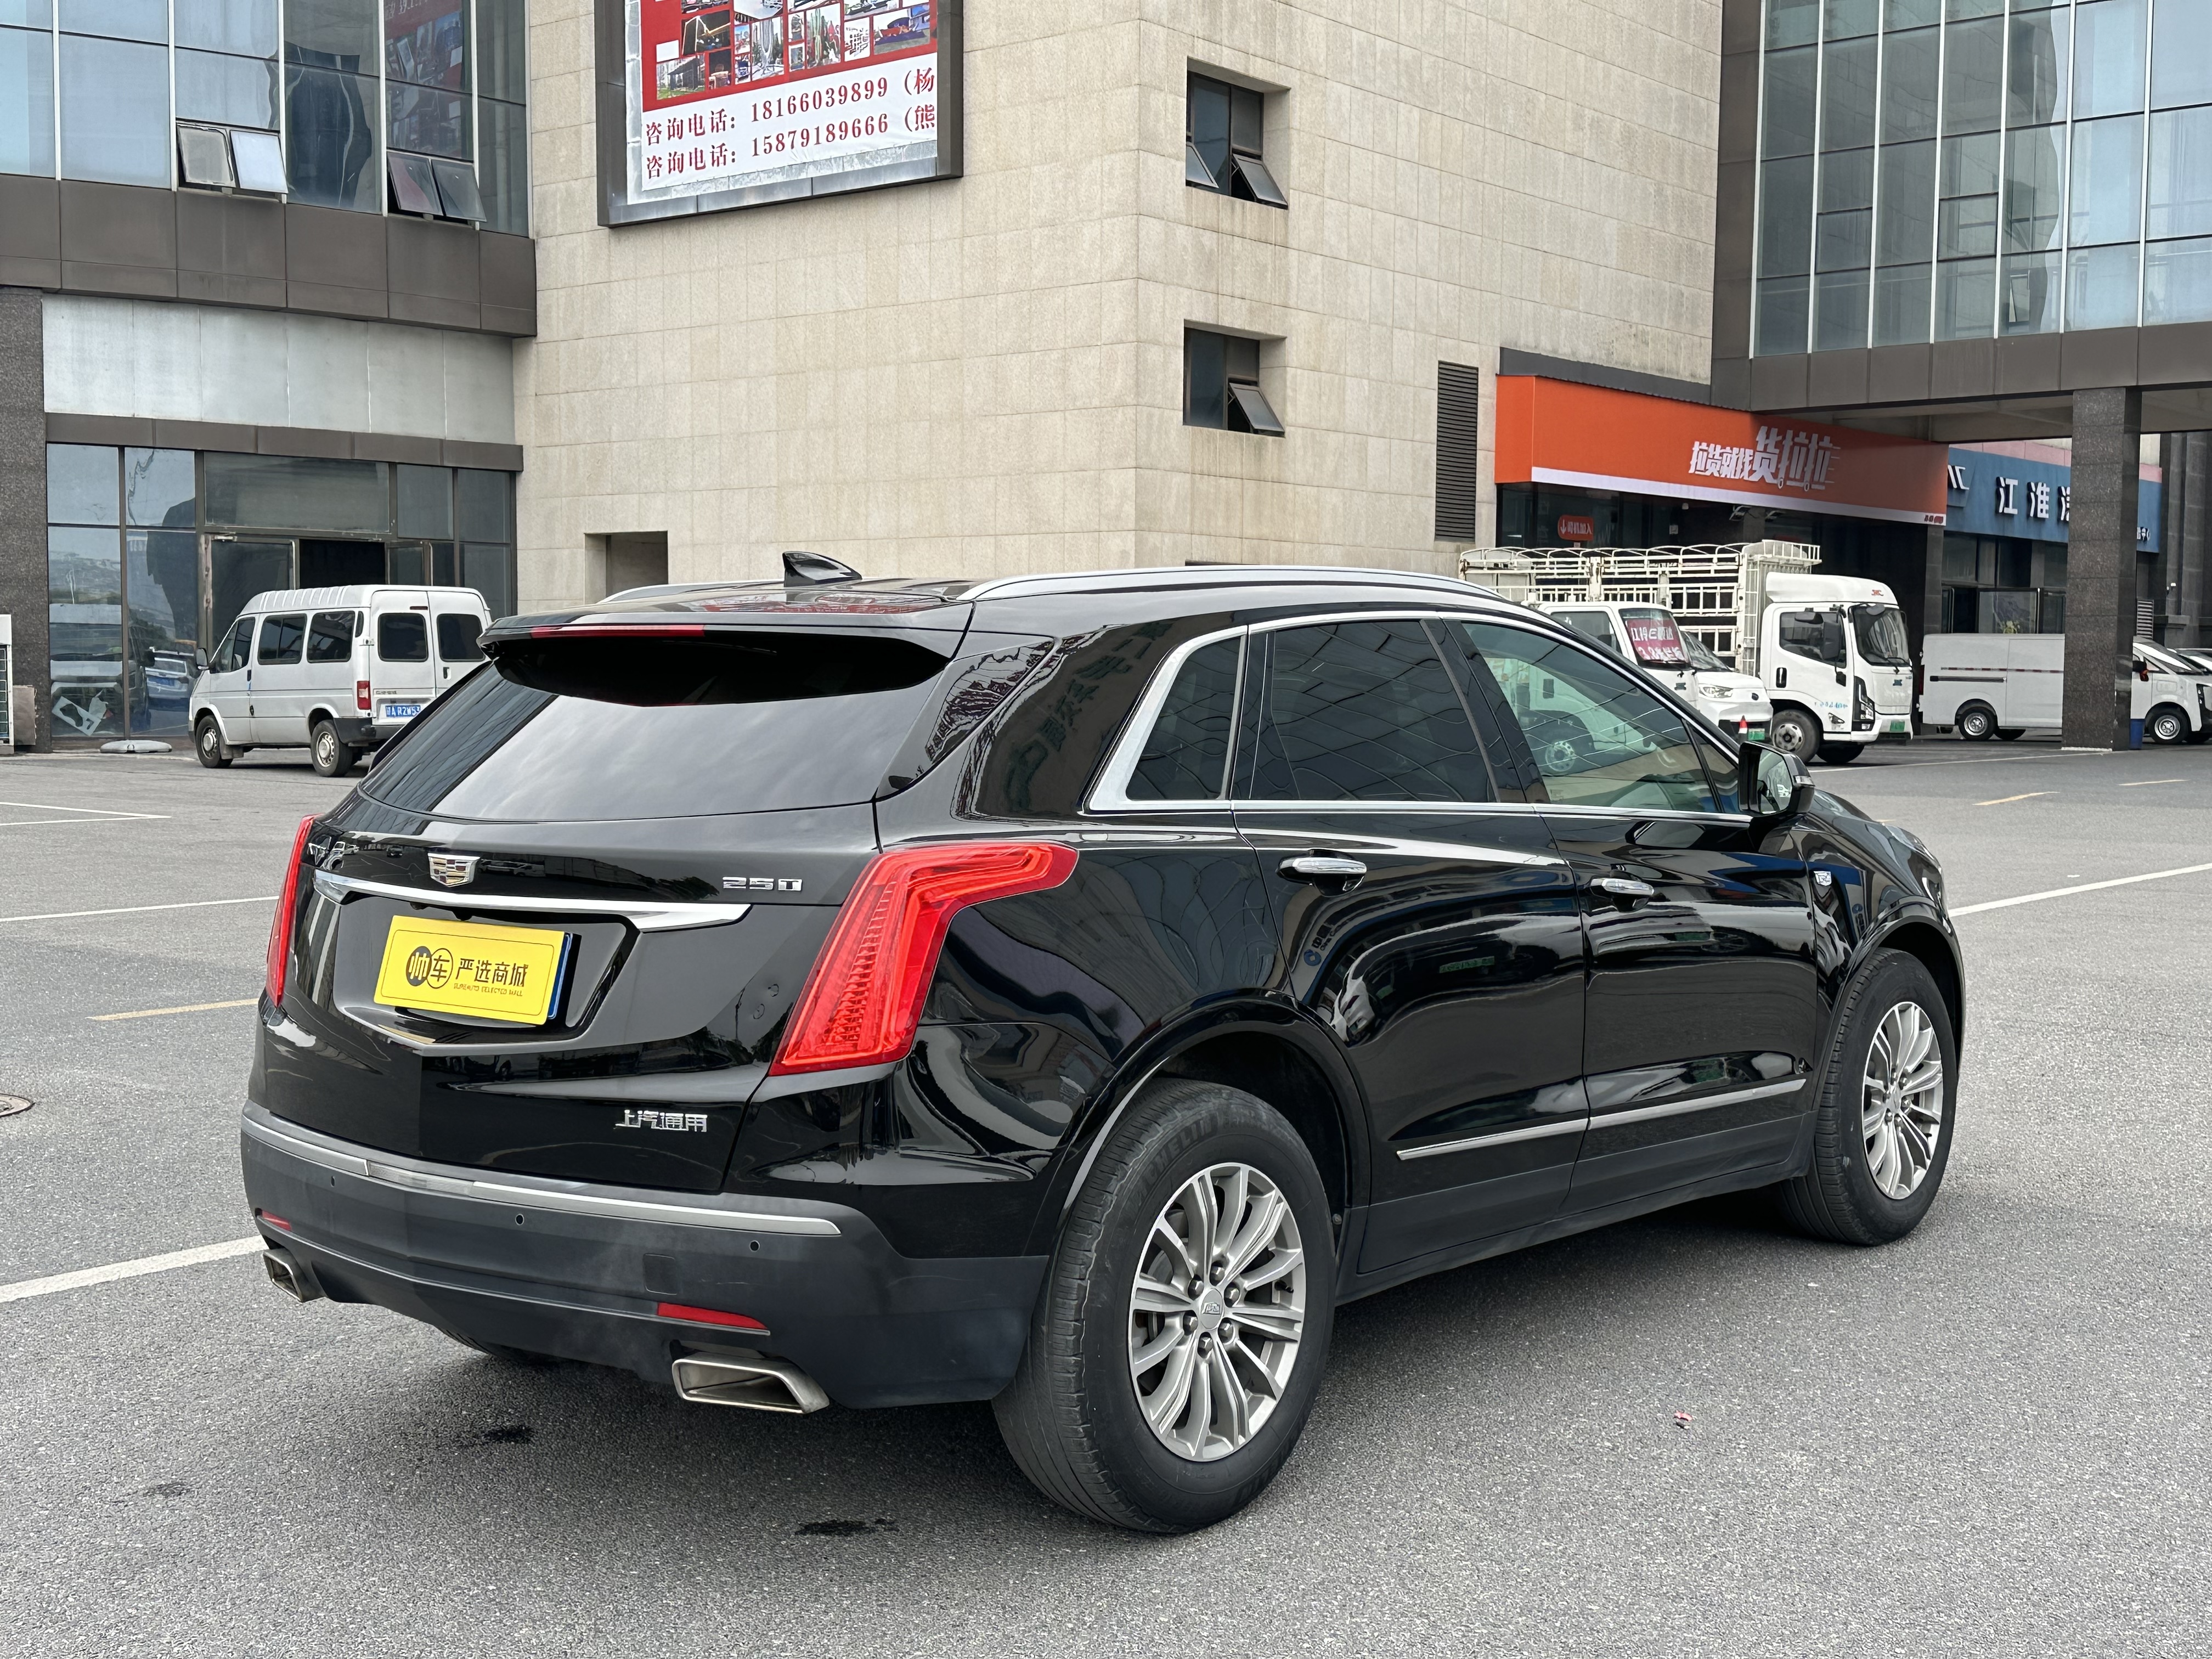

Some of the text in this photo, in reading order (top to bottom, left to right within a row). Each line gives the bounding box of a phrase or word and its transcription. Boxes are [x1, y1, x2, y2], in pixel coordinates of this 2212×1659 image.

[646, 109, 736, 146] 咨询电话：
[751, 77, 889, 122] 18166039899
[646, 143, 737, 179] 咨询电话：
[751, 113, 889, 157] 15879189666
[723, 876, 803, 891] 25T
[407, 950, 529, 988] 帅车 严选商城
[614, 1109, 708, 1132] 上汽通用
